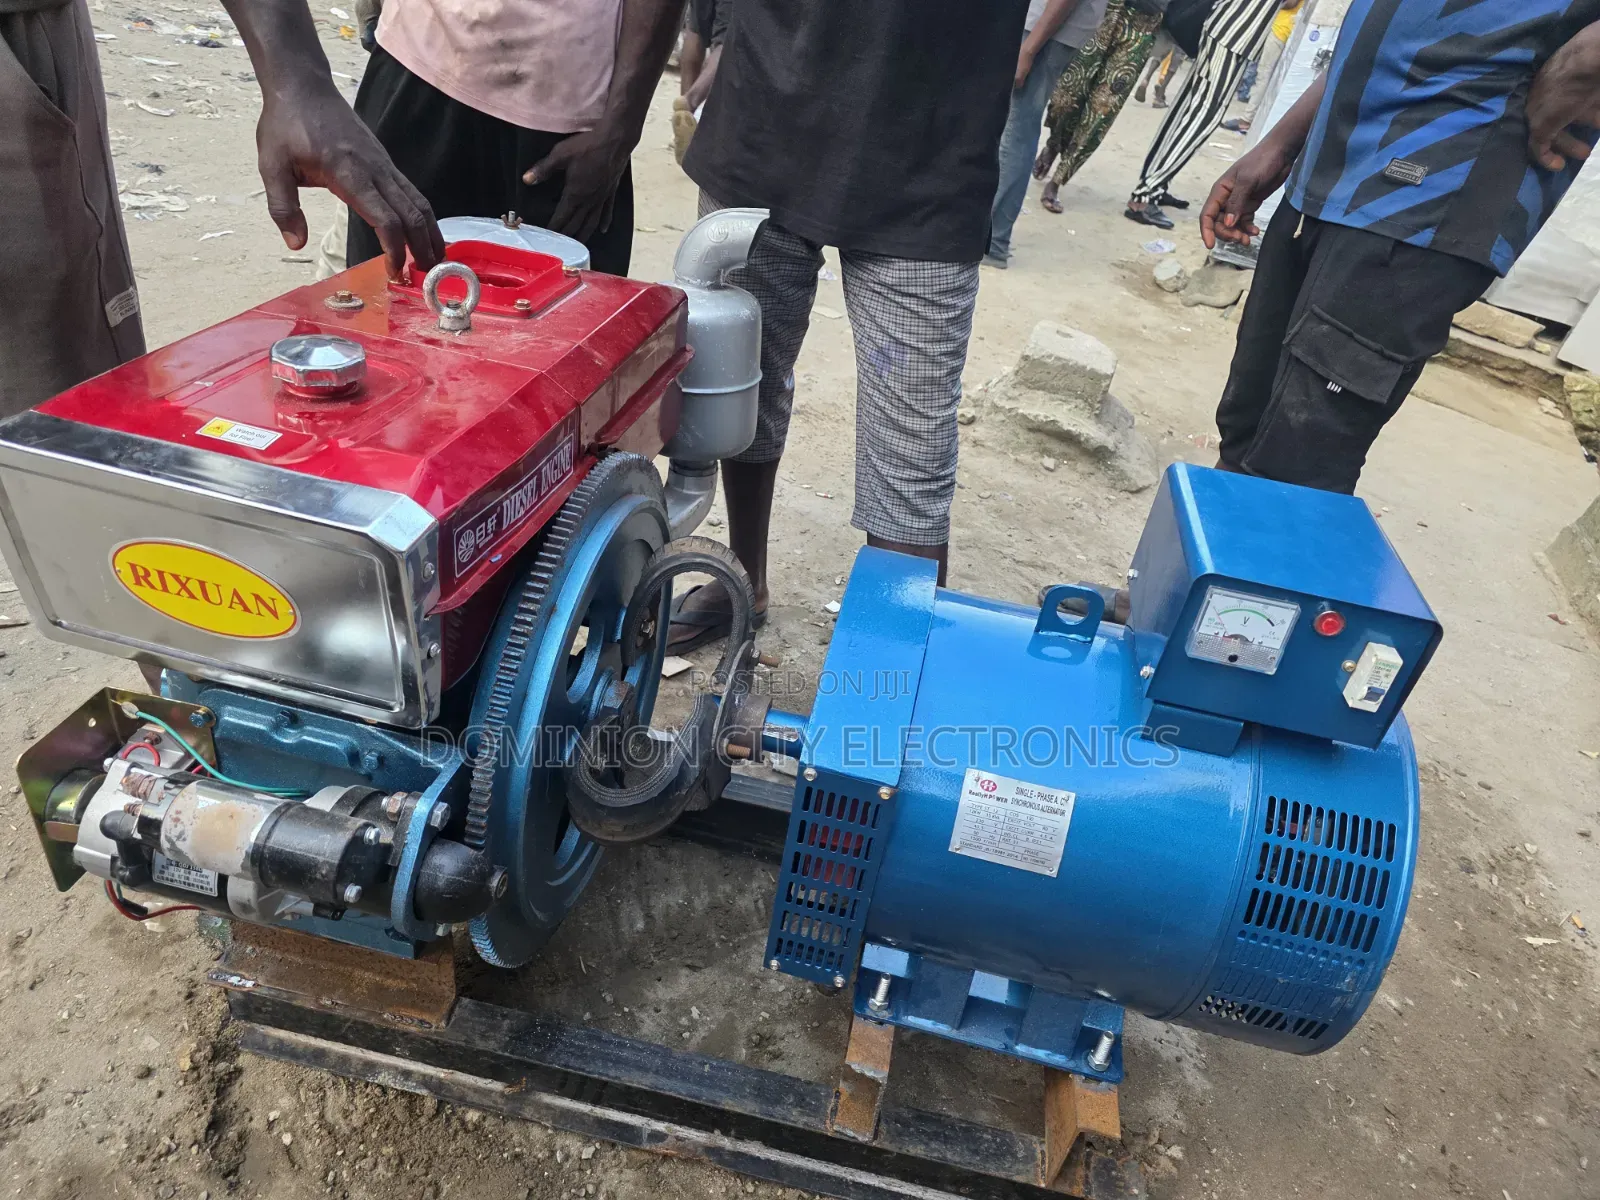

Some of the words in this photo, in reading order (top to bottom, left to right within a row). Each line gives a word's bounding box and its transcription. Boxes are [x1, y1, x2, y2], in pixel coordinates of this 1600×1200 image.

[236, 428, 255, 436] Watch
[502, 475, 538, 530] DIESEL
[540, 443, 571, 496] ENGINE
[126, 561, 281, 621] RIXUAN
[1244, 616, 1250, 625] V
[1015, 786, 1035, 798] SINGLE
[1037, 791, 1054, 803] PHASE
[1011, 797, 1041, 812] SYNCHRONOUS
